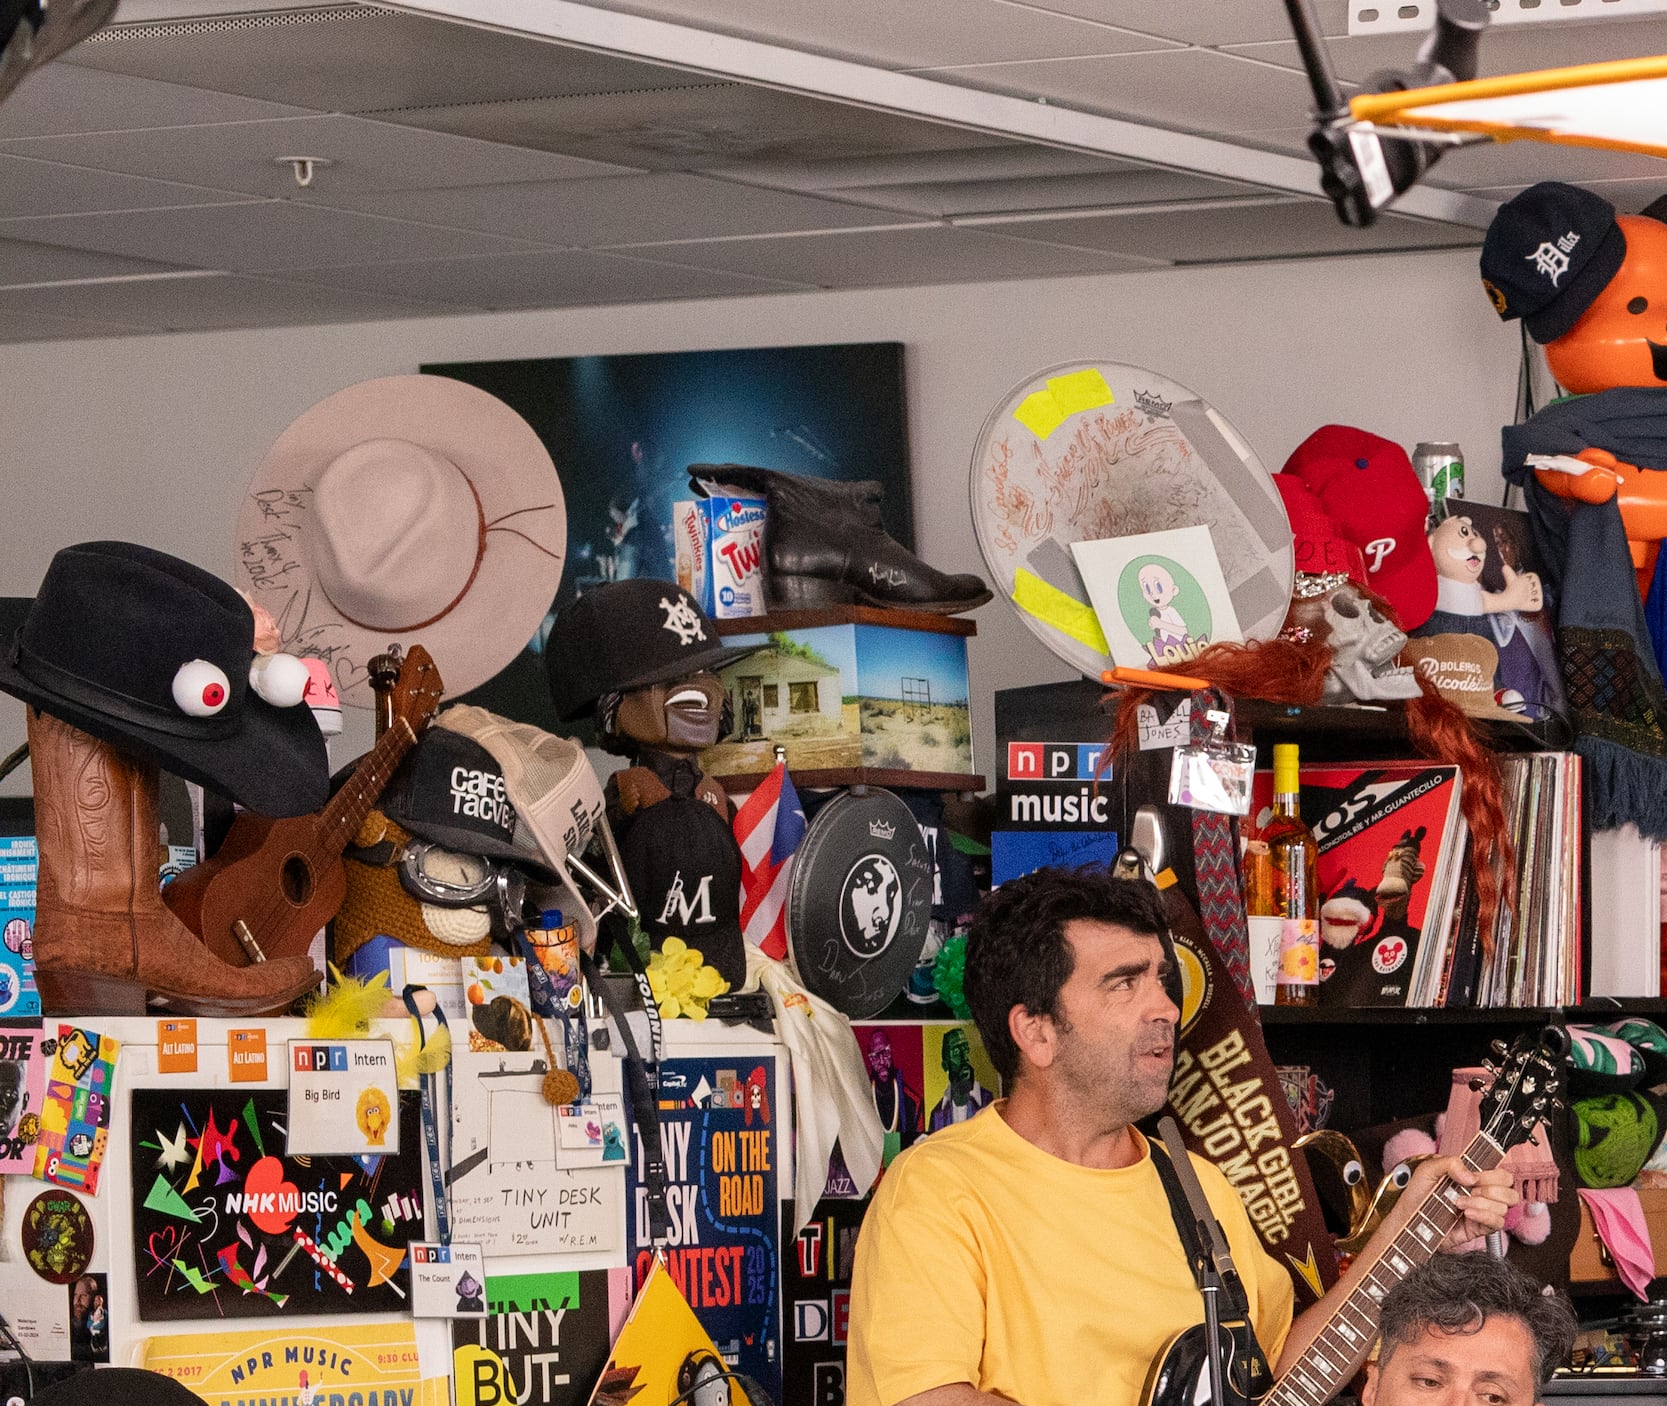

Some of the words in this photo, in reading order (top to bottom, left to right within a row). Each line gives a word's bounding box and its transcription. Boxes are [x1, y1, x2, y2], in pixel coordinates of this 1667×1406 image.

[724, 510, 766, 529] Hostess
[684, 509, 703, 573] Twinkies
[1366, 537, 1396, 573] P
[1440, 660, 1482, 675] BOLEROS
[1143, 725, 1181, 742] JONES
[1016, 748, 1108, 779] npr
[1010, 788, 1109, 823] music
[9, 890, 37, 900] CASTIGO
[634, 972, 663, 1060] MINUTOS
[162, 1041, 175, 1054] ALT
[175, 1041, 196, 1054] LATINO
[233, 1051, 244, 1064] ALT
[244, 1051, 266, 1065] LATINO
[297, 1047, 346, 1070] npr
[354, 1051, 388, 1066] Intern
[304, 1088, 320, 1103] Big
[321, 1088, 341, 1102] Bird
[561, 1106, 583, 1117] npr
[1199, 1027, 1281, 1151] BLACK
[1256, 1146, 1307, 1226] GIRL
[633, 1120, 692, 1183] TNY
[711, 1130, 737, 1174] ON
[740, 1129, 770, 1173] THE
[1168, 1048, 1242, 1161] BANJO
[1217, 1150, 1291, 1246] MAGIC
[501, 1188, 548, 1209] TINY
[558, 1186, 602, 1207] DESK
[719, 1175, 763, 1217] ROAD
[824, 1177, 852, 1195] JAZZ
[225, 1193, 275, 1215] NHK
[279, 1191, 338, 1215] MUSIC
[529, 1210, 572, 1231] UNIT
[635, 1185, 699, 1247] DSK
[415, 1246, 450, 1263] npr
[454, 1250, 478, 1263] Intern
[747, 1245, 765, 1274] 20
[418, 1273, 432, 1284] The
[432, 1273, 451, 1284] Count
[636, 1246, 744, 1306] CNTEST
[747, 1275, 765, 1304] 25
[478, 1296, 571, 1351] TINY
[230, 1350, 275, 1386] NPR
[285, 1345, 353, 1377] MUSIC
[377, 1354, 401, 1365] 9:30
[176, 1366, 204, 1379] 2017
